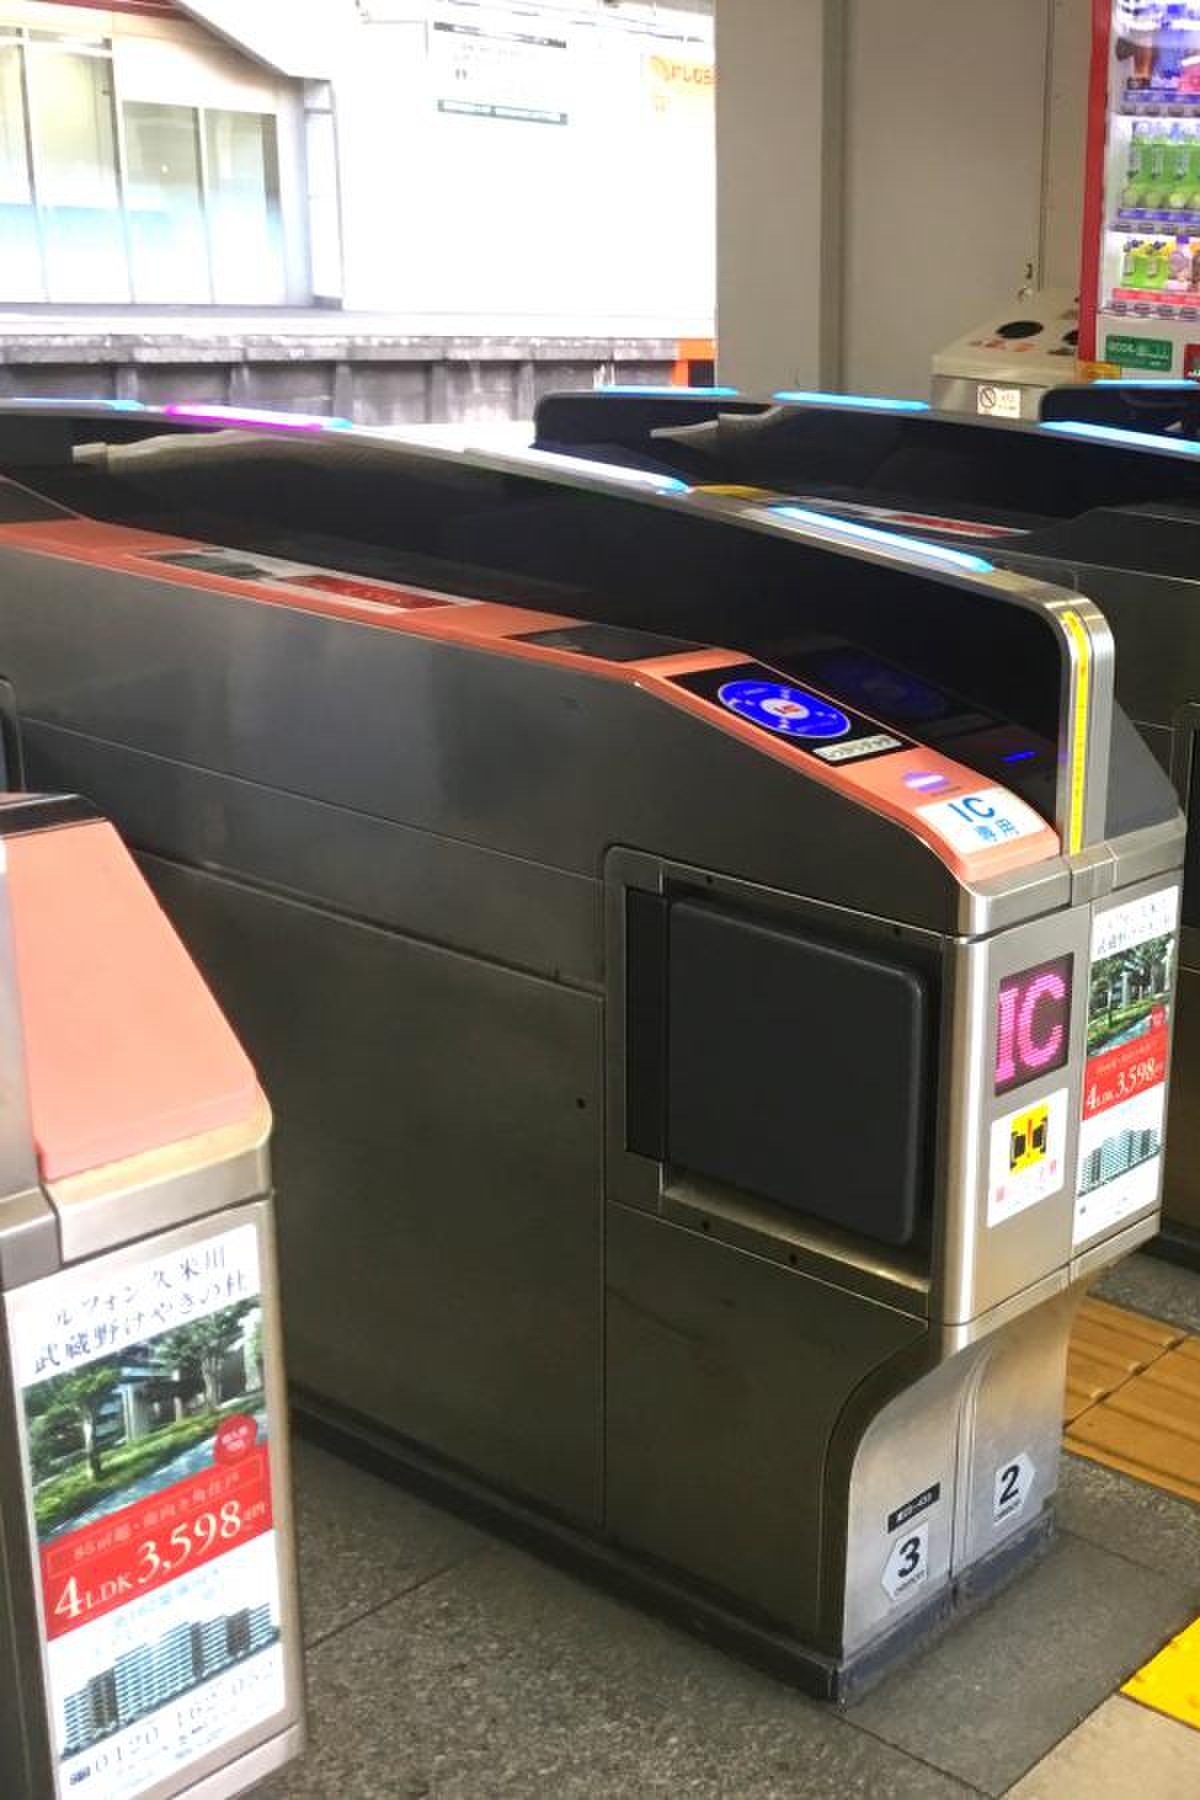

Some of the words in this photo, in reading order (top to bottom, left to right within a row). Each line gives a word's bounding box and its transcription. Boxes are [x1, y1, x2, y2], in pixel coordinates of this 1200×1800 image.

[947, 797, 995, 823] IC
[994, 972, 1066, 1085] IC
[999, 1464, 1021, 1506] 2
[897, 1537, 922, 1579] 3
